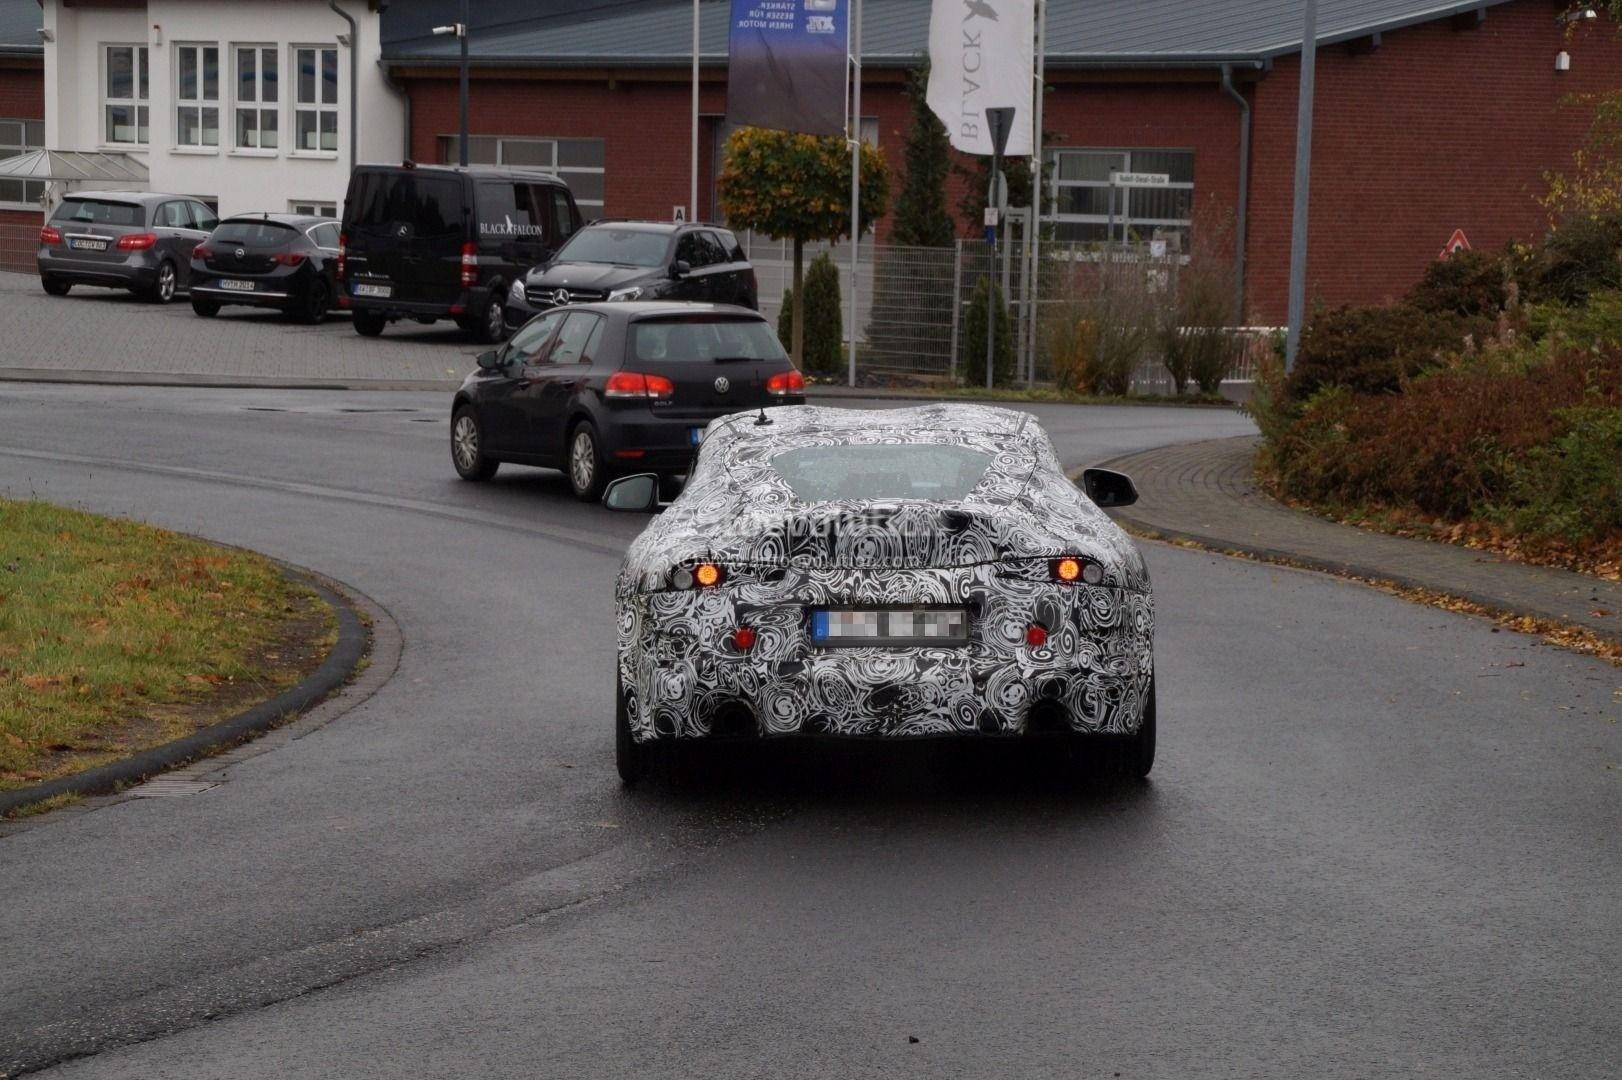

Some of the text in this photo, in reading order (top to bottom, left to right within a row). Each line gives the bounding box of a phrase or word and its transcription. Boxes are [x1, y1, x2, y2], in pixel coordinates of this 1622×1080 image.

[675, 209, 683, 221] A
[480, 222, 543, 236] BLACK FALCON
